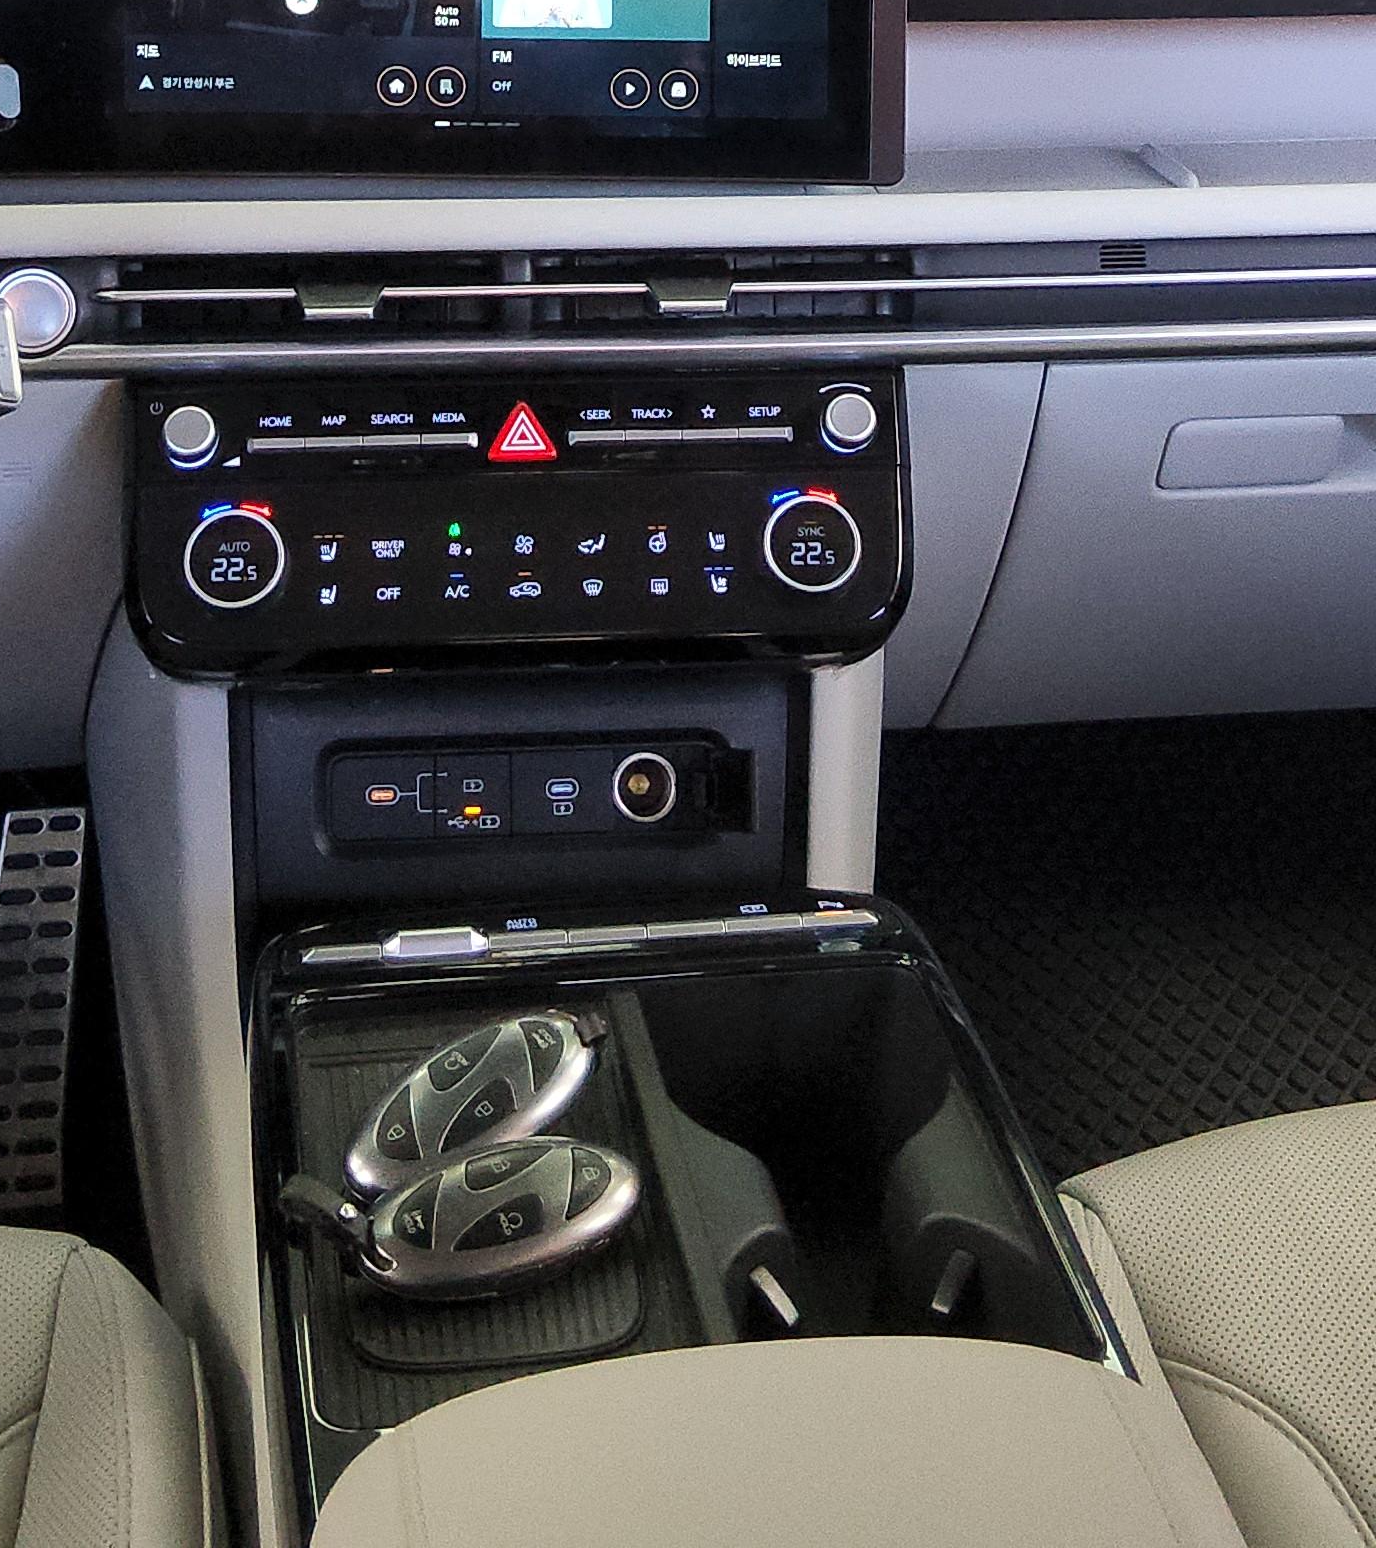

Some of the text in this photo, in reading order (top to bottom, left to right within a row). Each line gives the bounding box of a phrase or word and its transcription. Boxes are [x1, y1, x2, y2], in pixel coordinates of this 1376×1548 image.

[434, 5, 460, 16] Auto
[136, 44, 160, 59] 지도
[492, 51, 512, 63] FM
[726, 53, 782, 68] 하이브리드
[491, 80, 512, 92] Off
[431, 412, 466, 424] MEDIA
[748, 406, 782, 418] SETUP
[258, 416, 293, 429] HOME
[320, 415, 347, 427] MAP
[370, 413, 414, 426] SEARCH
[797, 526, 826, 538] SYNC
[218, 541, 251, 553] AUTO
[371, 539, 405, 550] DRIVER
[375, 548, 401, 559] ONLY
[376, 588, 402, 601] OFF
[444, 585, 471, 598] A/C
